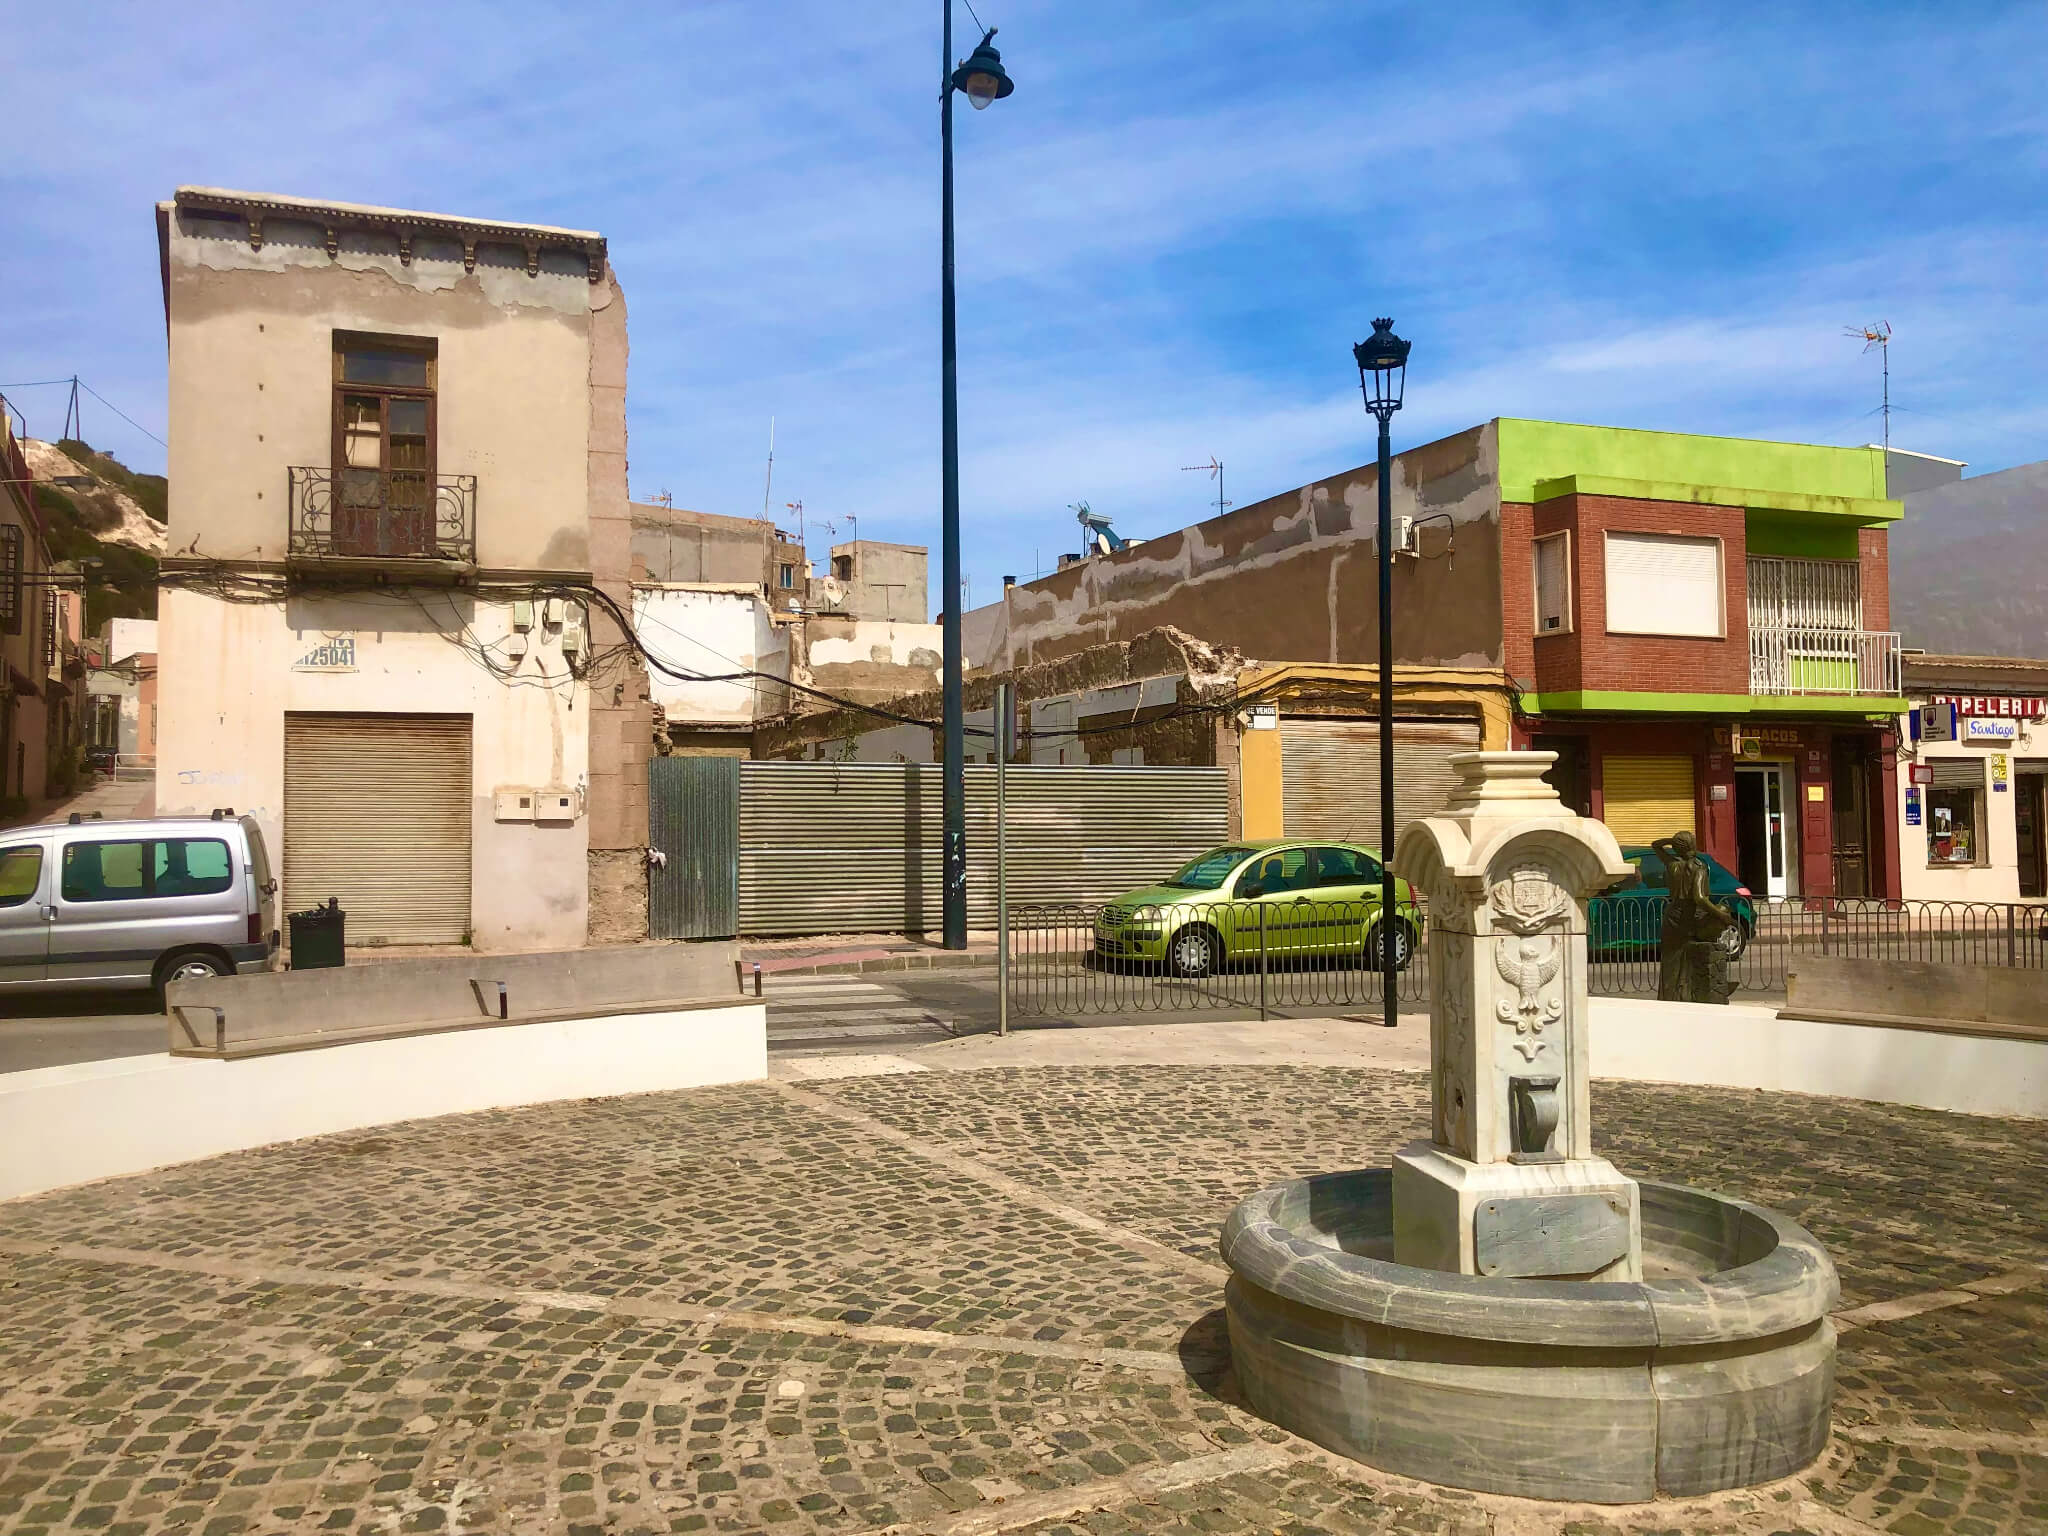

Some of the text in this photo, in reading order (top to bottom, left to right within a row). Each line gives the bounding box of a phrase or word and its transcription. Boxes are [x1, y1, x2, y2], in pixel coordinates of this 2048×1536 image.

[1246, 706, 1276, 715] SE VENDE
[1742, 728, 1799, 743] ABACOS
[1970, 720, 2015, 738] Santiago
